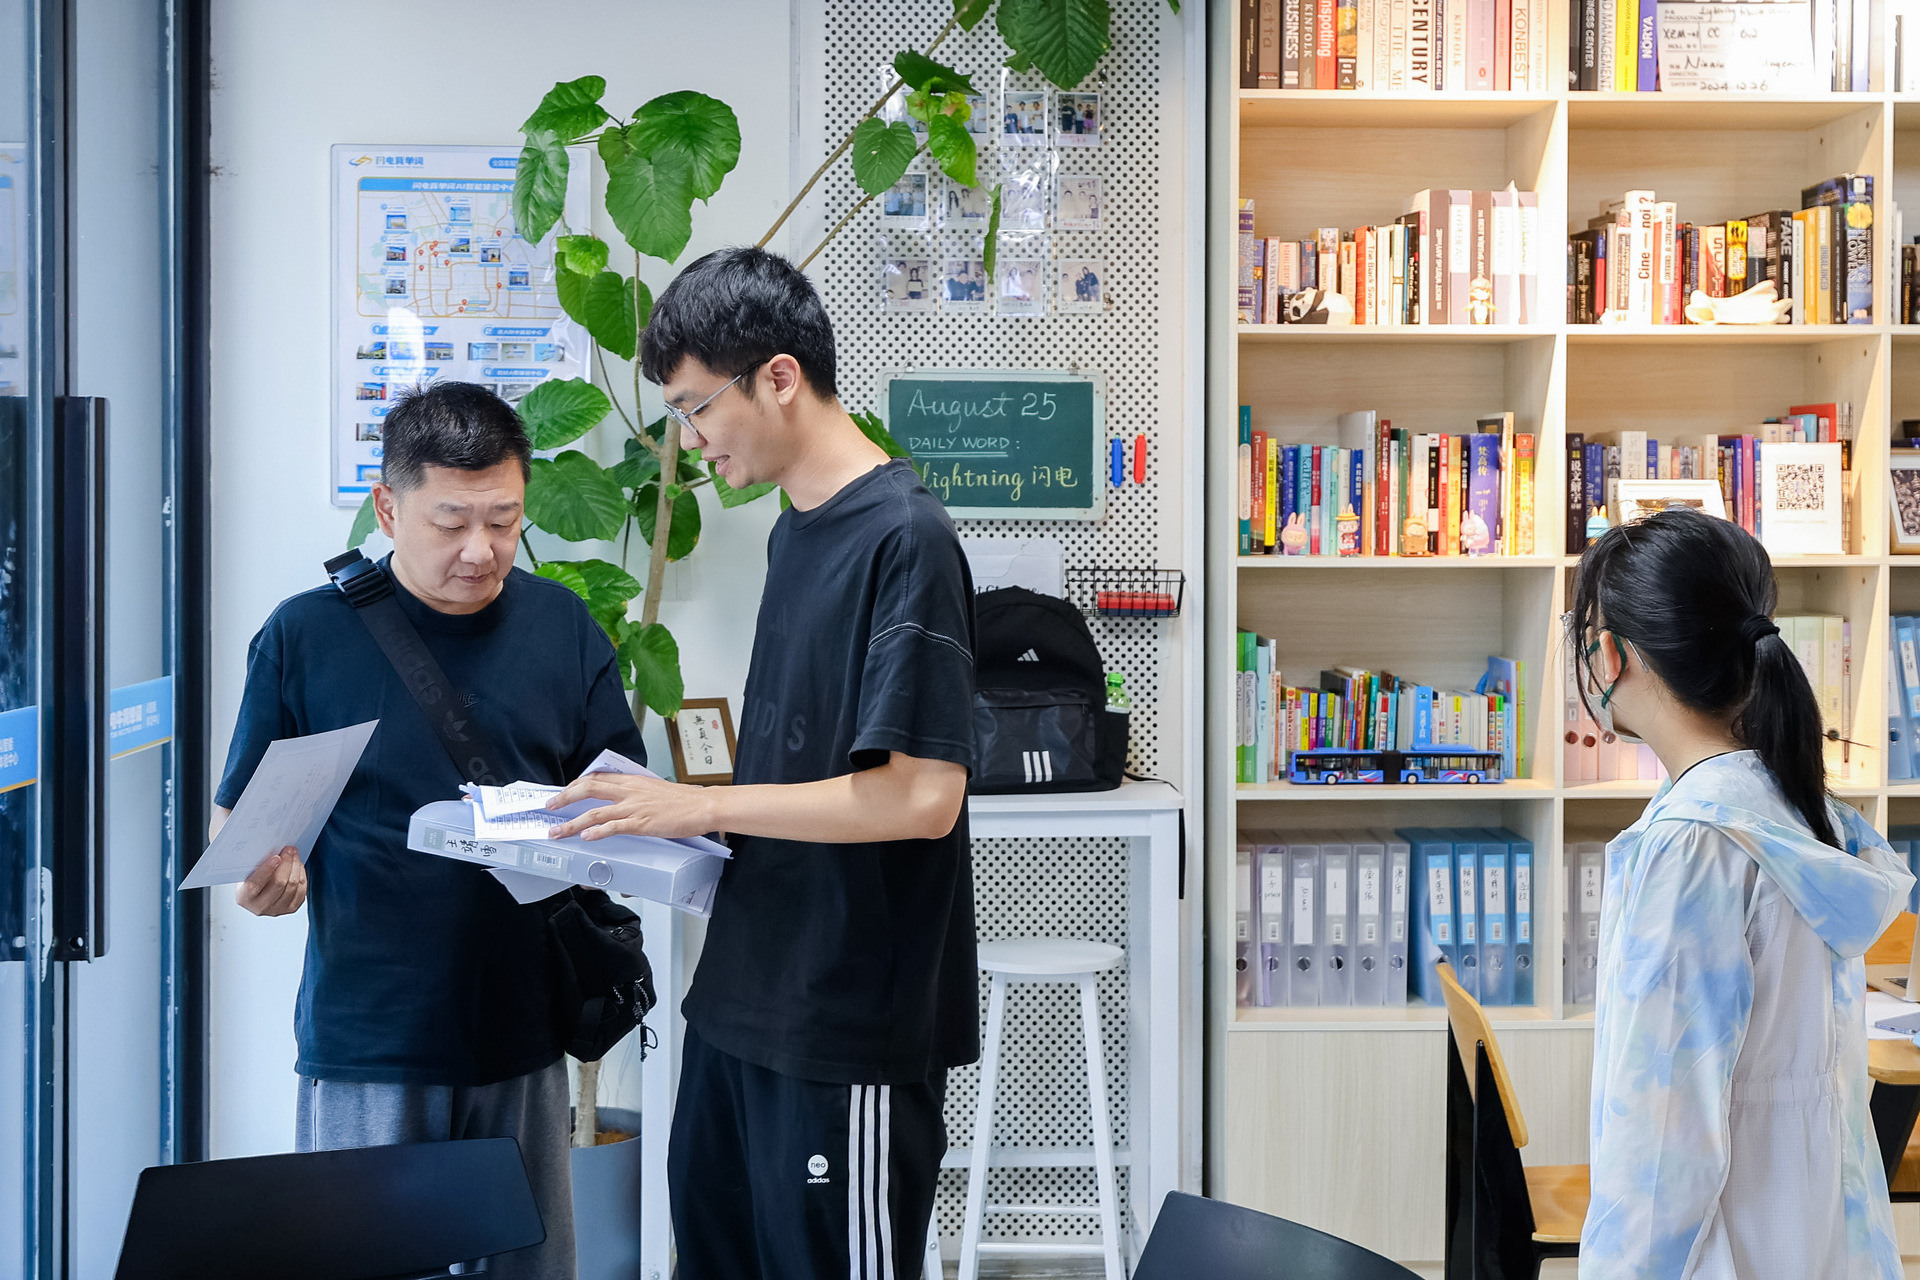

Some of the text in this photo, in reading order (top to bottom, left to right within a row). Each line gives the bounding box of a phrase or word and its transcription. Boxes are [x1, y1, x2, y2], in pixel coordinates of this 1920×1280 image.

[1304, 4, 1314, 58] KINFOLK
[1454, 14, 1463, 67] KINFOLK
[1514, 7, 1528, 82] KONBEST
[1586, 29, 1595, 68] CENTER
[1601, 12, 1614, 89] MANAGEMENT
[1639, 209, 1652, 229] noi
[1781, 216, 1792, 256] FAKE
[1638, 252, 1651, 280] Cine
[1820, 245, 1828, 290] UNBALANCED
[1848, 229, 1858, 283] FLOWERS
[1858, 229, 1867, 271] PLANTS
[907, 388, 1057, 433] August 25
[908, 437, 956, 450] DAILY
[1477, 446, 1489, 477] 梵高传
[1032, 465, 1078, 488] 闪电
[806, 1176, 831, 1185] adidas
[810, 1159, 827, 1169] neo
